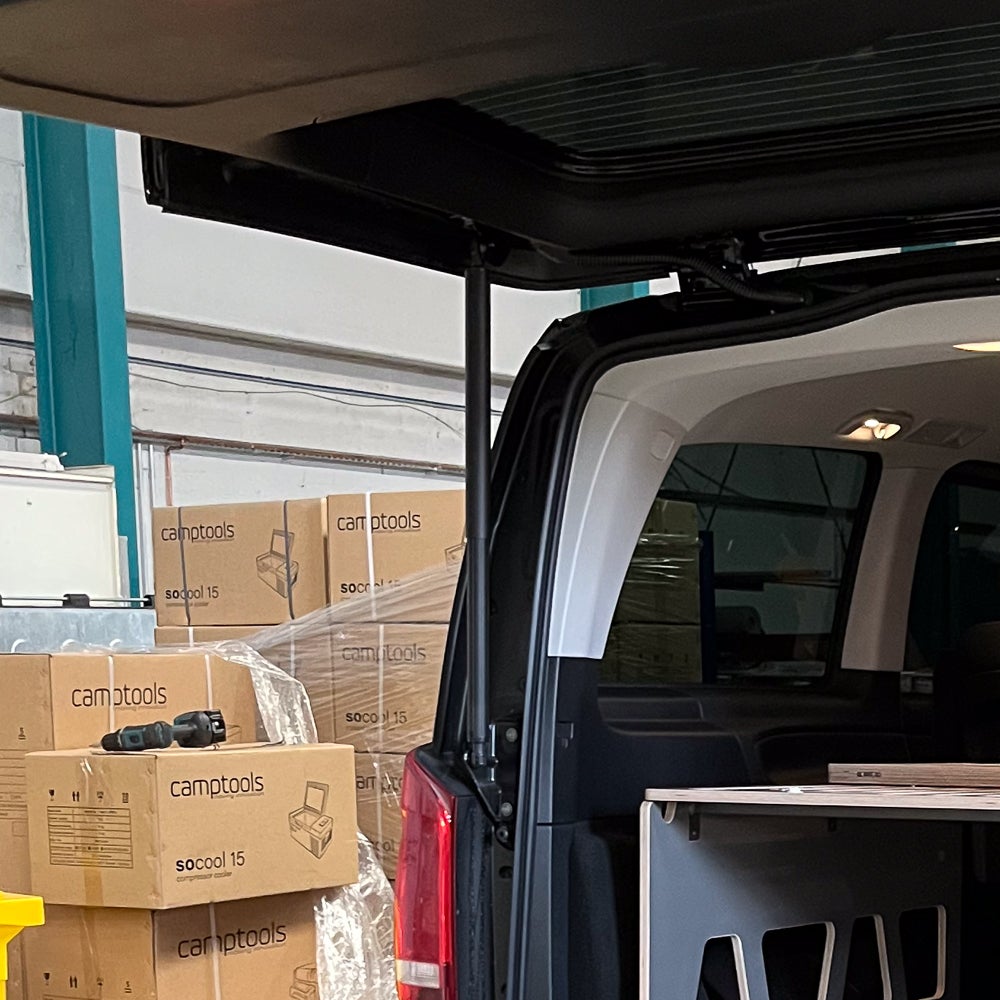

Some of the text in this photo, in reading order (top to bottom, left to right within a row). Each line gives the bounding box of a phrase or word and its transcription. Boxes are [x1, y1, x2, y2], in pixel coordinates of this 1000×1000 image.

[161, 521, 235, 543] camptools
[337, 510, 421, 534] camptools
[207, 586, 219, 599] 15
[393, 711, 408, 724] 15
[170, 771, 264, 799] camptools
[176, 851, 245, 872] socool 15
[178, 922, 287, 958] camptools
